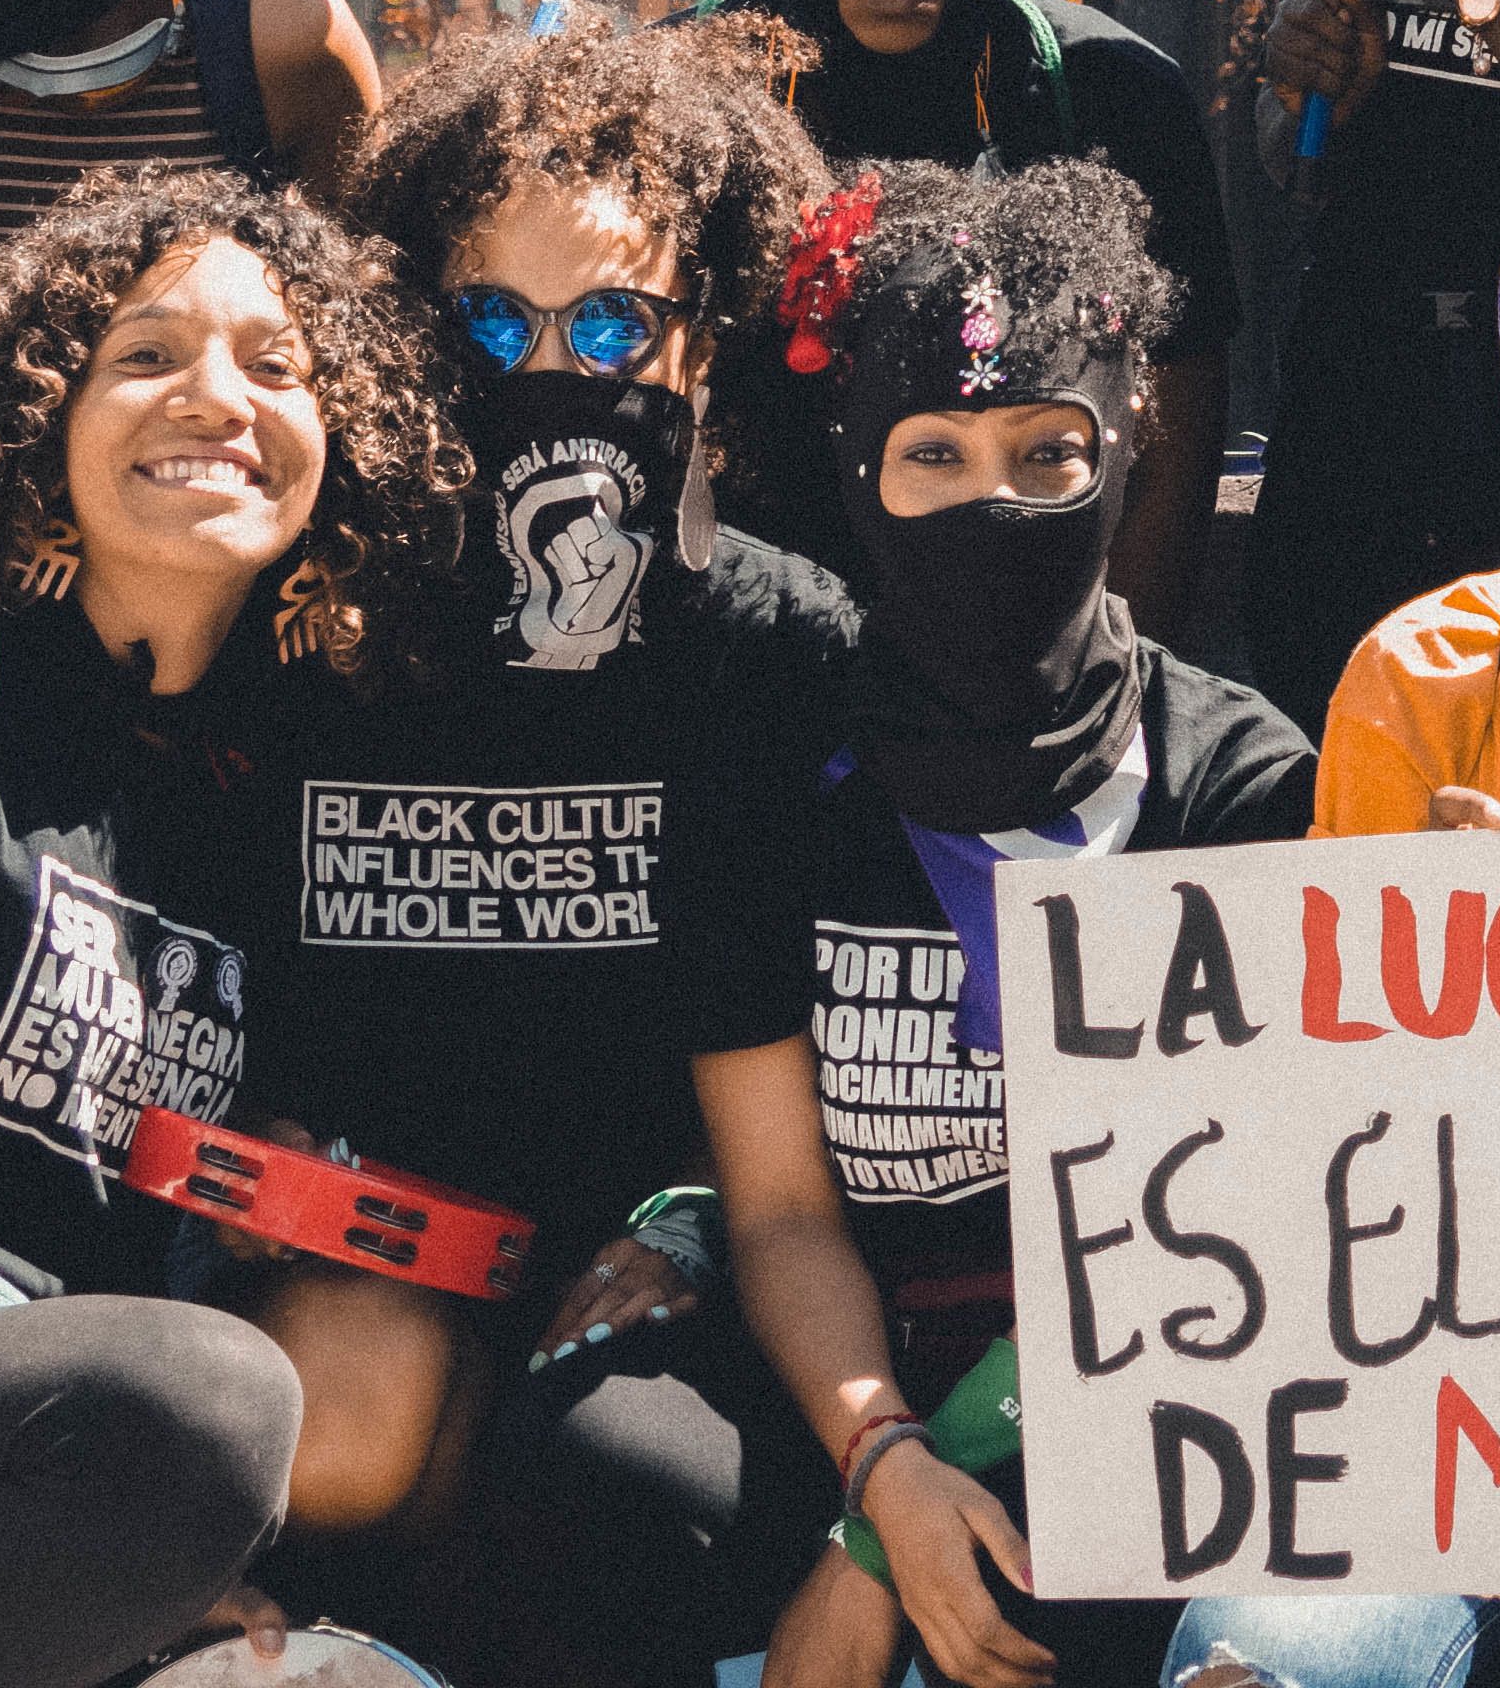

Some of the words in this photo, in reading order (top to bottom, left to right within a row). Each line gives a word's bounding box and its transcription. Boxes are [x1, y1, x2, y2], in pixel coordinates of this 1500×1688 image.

[502, 441, 548, 492] SERÁ
[316, 795, 475, 841] BLACK
[316, 844, 596, 890] INFLUENCES
[50, 892, 120, 976] SER
[316, 891, 502, 938] WHOLE
[31, 953, 144, 1044] MUJER
[147, 1009, 246, 1082] NEGRA
[1034, 881, 1266, 1060] LA
[7, 1006, 80, 1070] ES
[110, 1049, 236, 1125] ESENCIA
[1050, 1116, 1269, 1379] ES
[1149, 1377, 1354, 1582] DE
